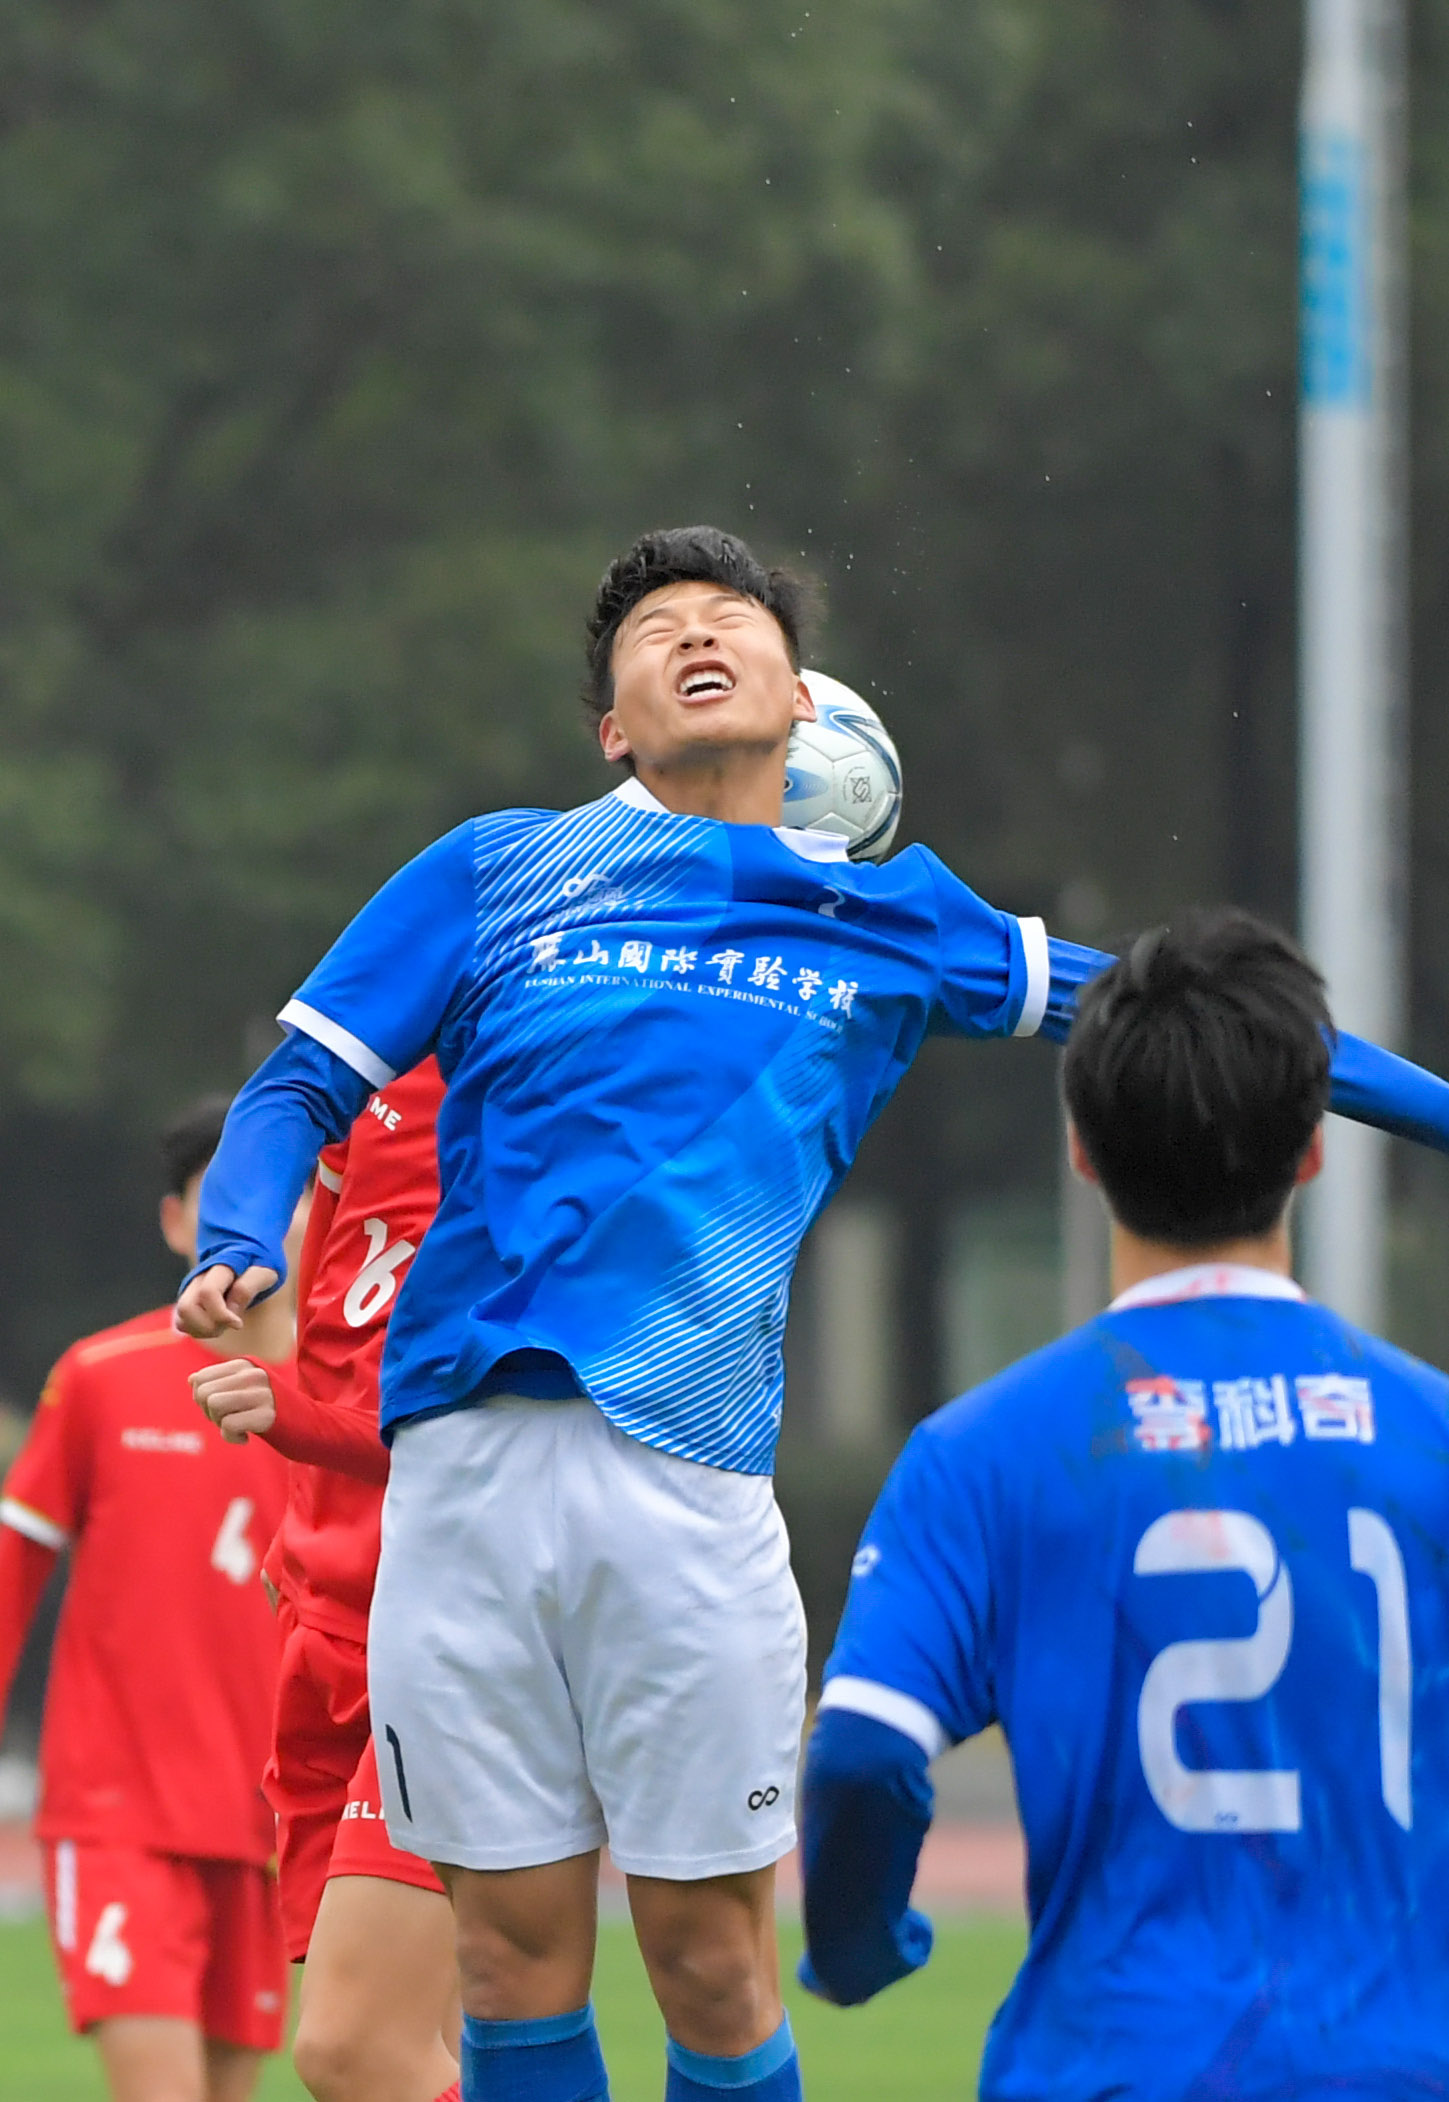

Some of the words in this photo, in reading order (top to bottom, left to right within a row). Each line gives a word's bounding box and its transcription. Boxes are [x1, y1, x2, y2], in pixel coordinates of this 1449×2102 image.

[580, 974, 692, 993] INTERNATIONAL
[697, 984, 801, 1017] EXPERIMENTAL
[343, 1217, 416, 1328] 16
[1133, 1506, 1413, 1833] 21
